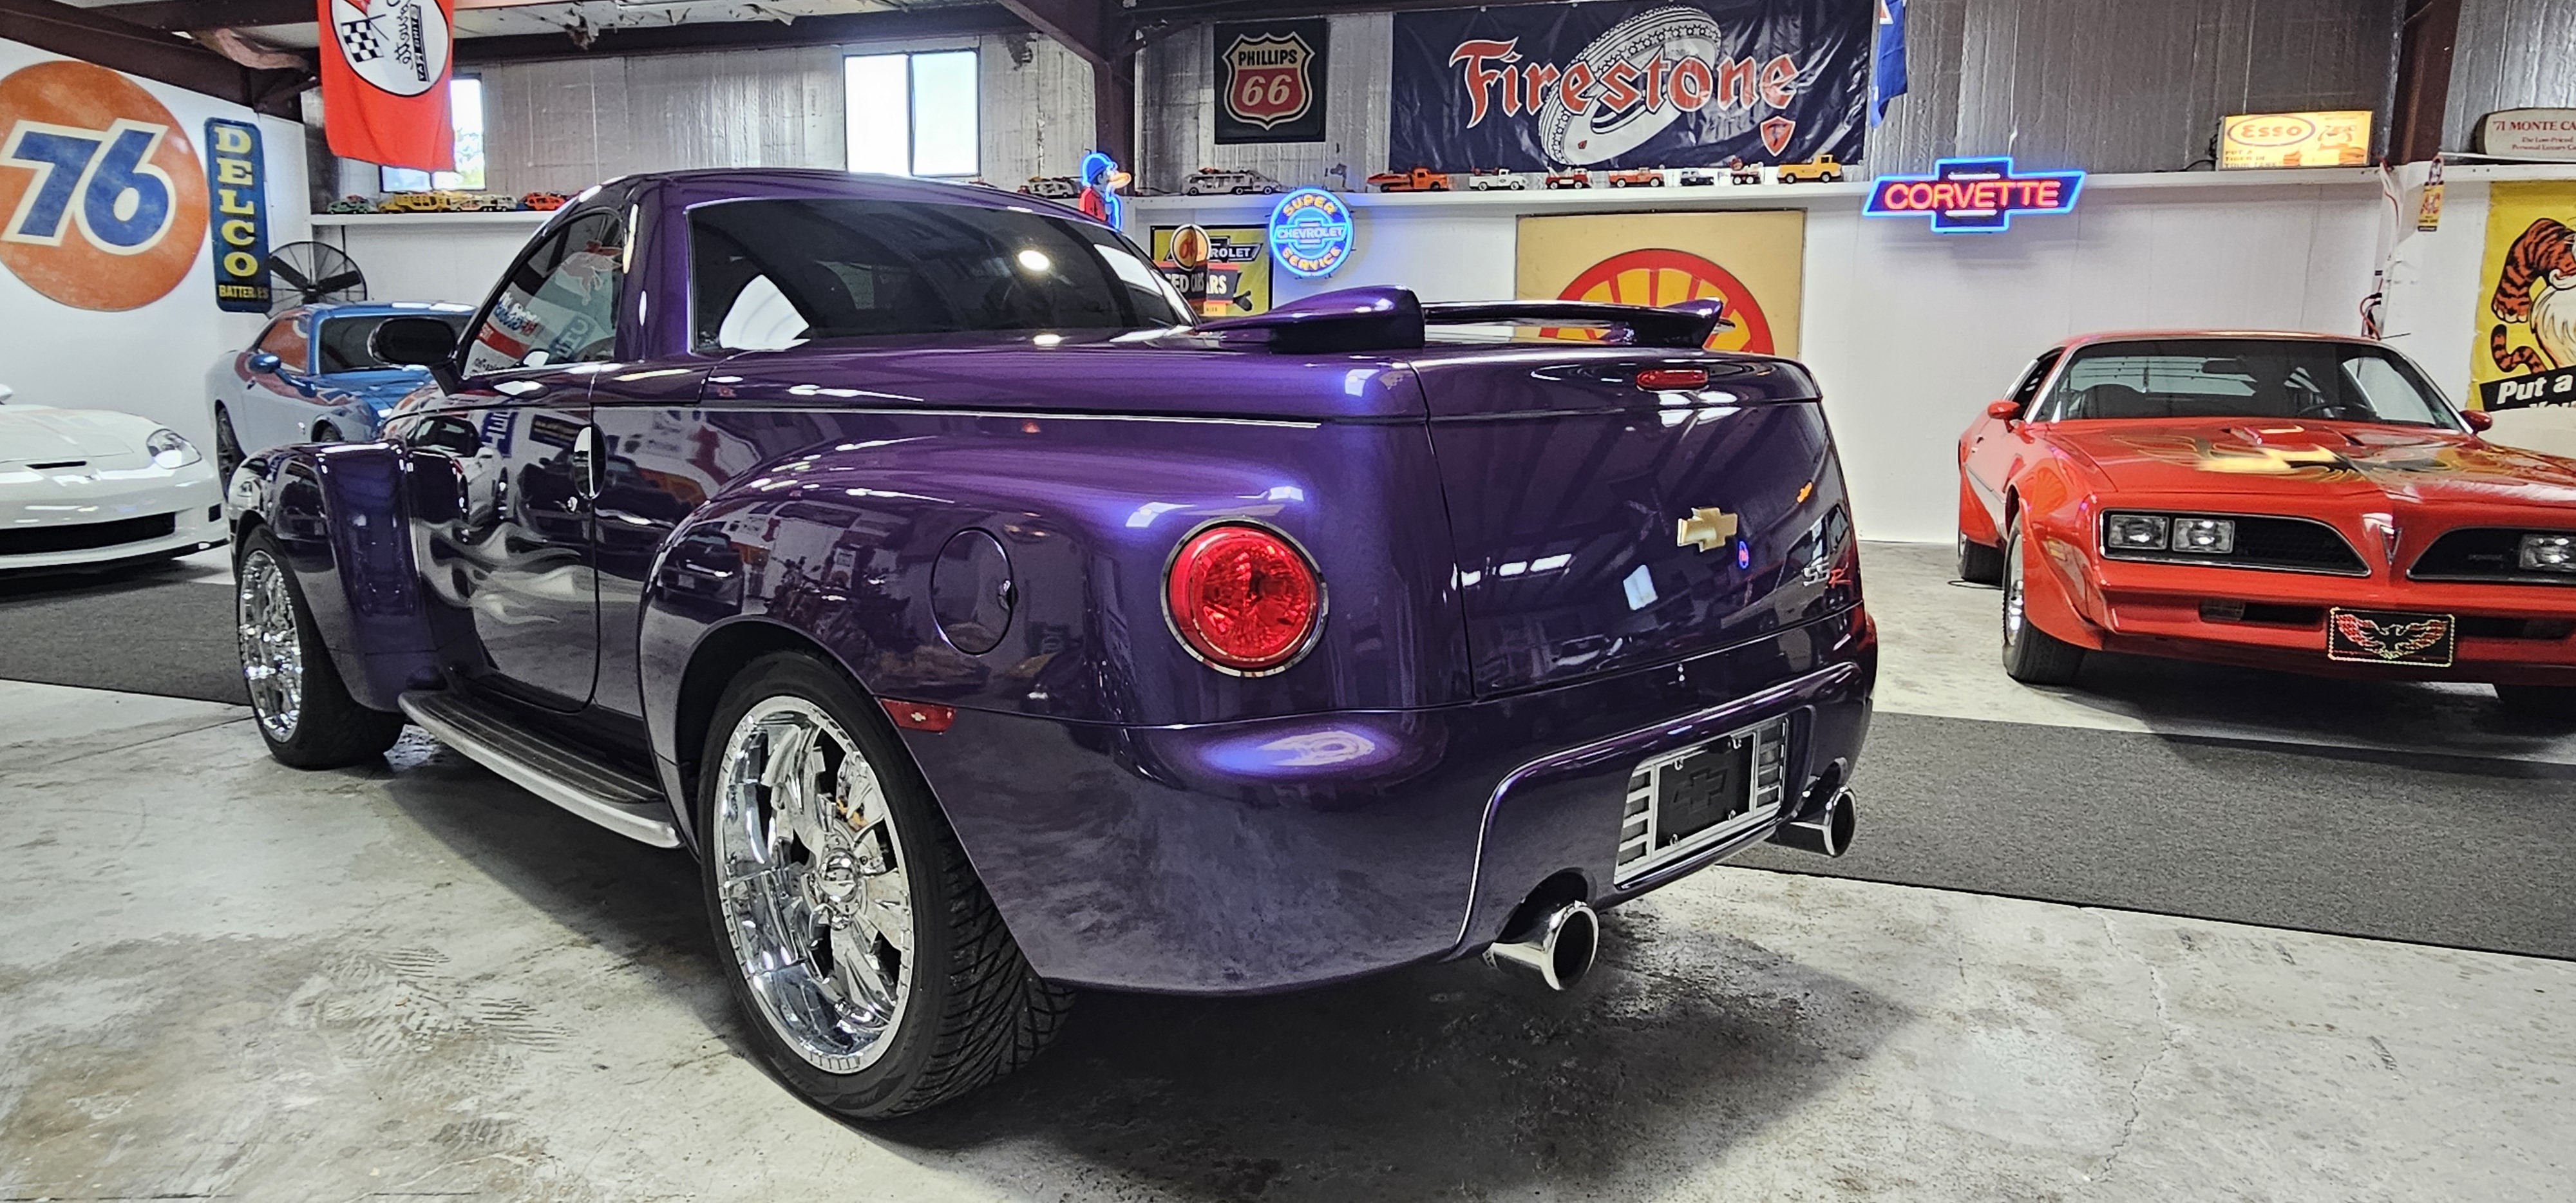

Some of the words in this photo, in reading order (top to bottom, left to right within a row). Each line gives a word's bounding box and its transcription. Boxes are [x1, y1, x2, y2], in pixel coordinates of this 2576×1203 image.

[1238, 50, 1298, 66] PHILLIPS
[1241, 74, 1293, 106] 66
[1449, 37, 1799, 129] Firestone
[2510, 120, 2557, 131] MONTE
[3, 120, 175, 253] 76
[1884, 180, 2061, 210] CORVETTE
[214, 127, 258, 277] DELCO
[1283, 194, 1337, 216] SUPER
[1277, 226, 1344, 239] CHEVROLET
[1211, 247, 1251, 258] ROLET
[1282, 247, 1341, 270] SERVICE
[2496, 377, 2547, 404] Put
[2553, 374, 2573, 393] a
[1803, 563, 1852, 587] SSR
